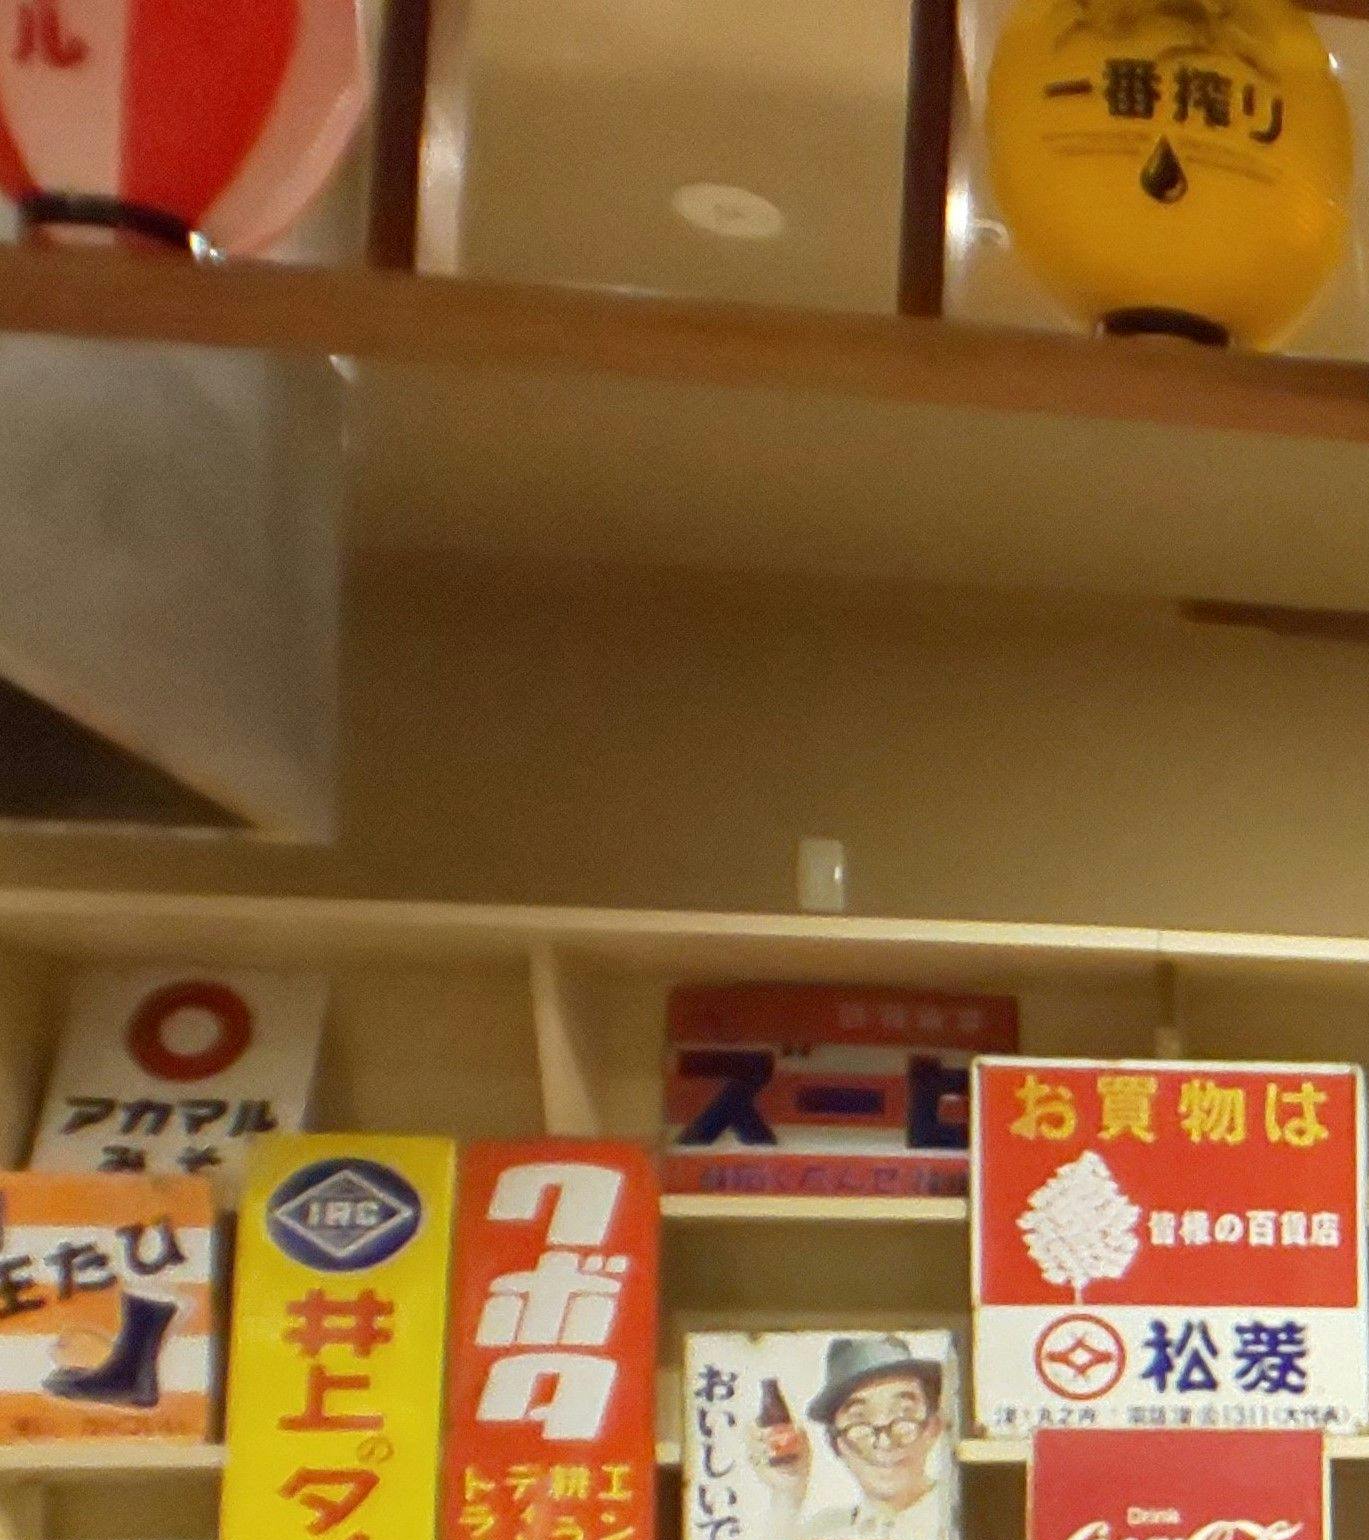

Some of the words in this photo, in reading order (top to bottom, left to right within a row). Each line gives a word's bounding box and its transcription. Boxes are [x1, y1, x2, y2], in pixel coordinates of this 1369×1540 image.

[1044, 57, 1284, 144] 一番搾り
[61, 1097, 278, 1136] アカマル
[1009, 1075, 1330, 1146] お買物は
[474, 1161, 629, 1441] クボタ
[1141, 1318, 1308, 1394] 松菱
